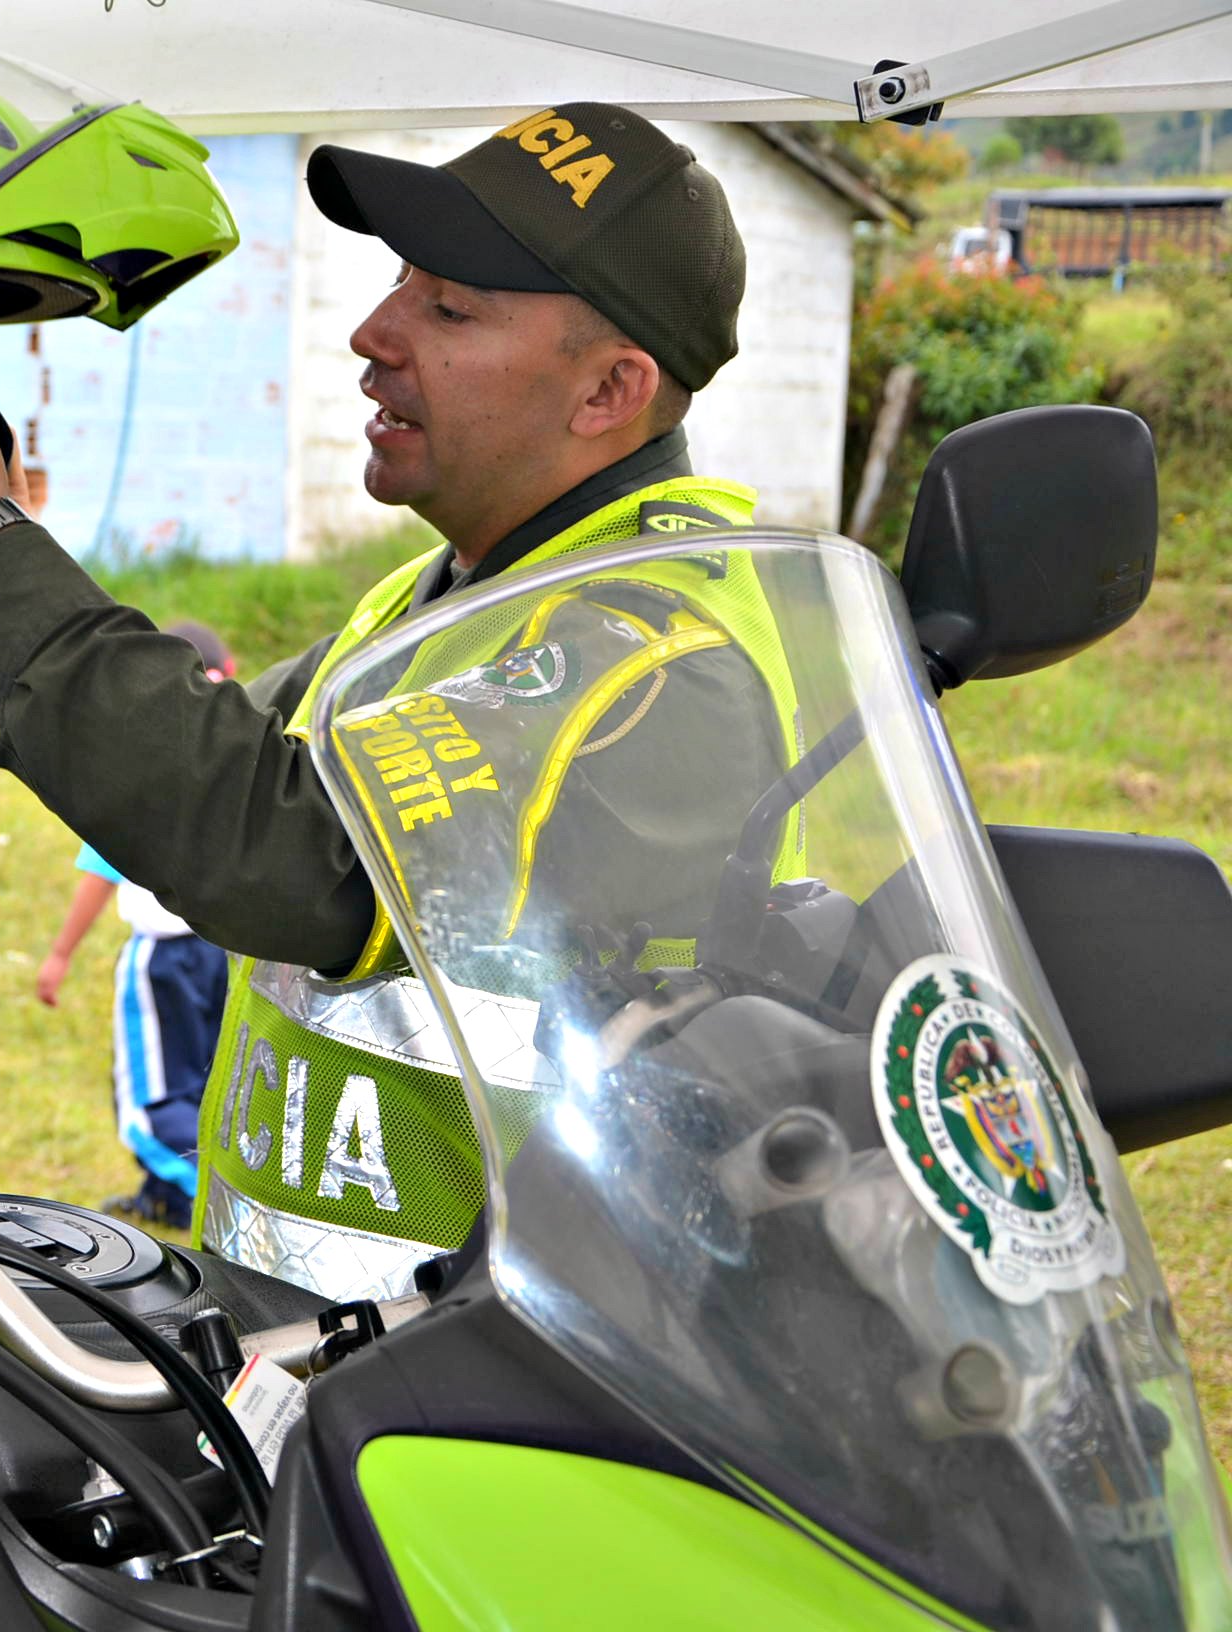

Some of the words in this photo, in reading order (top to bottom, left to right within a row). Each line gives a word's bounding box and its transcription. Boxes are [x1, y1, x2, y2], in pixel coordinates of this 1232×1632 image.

[493, 108, 616, 209] ICIA
[450, 763, 500, 793] Y
[272, 1395, 290, 1420] vayas
[267, 1418, 279, 1432] en
